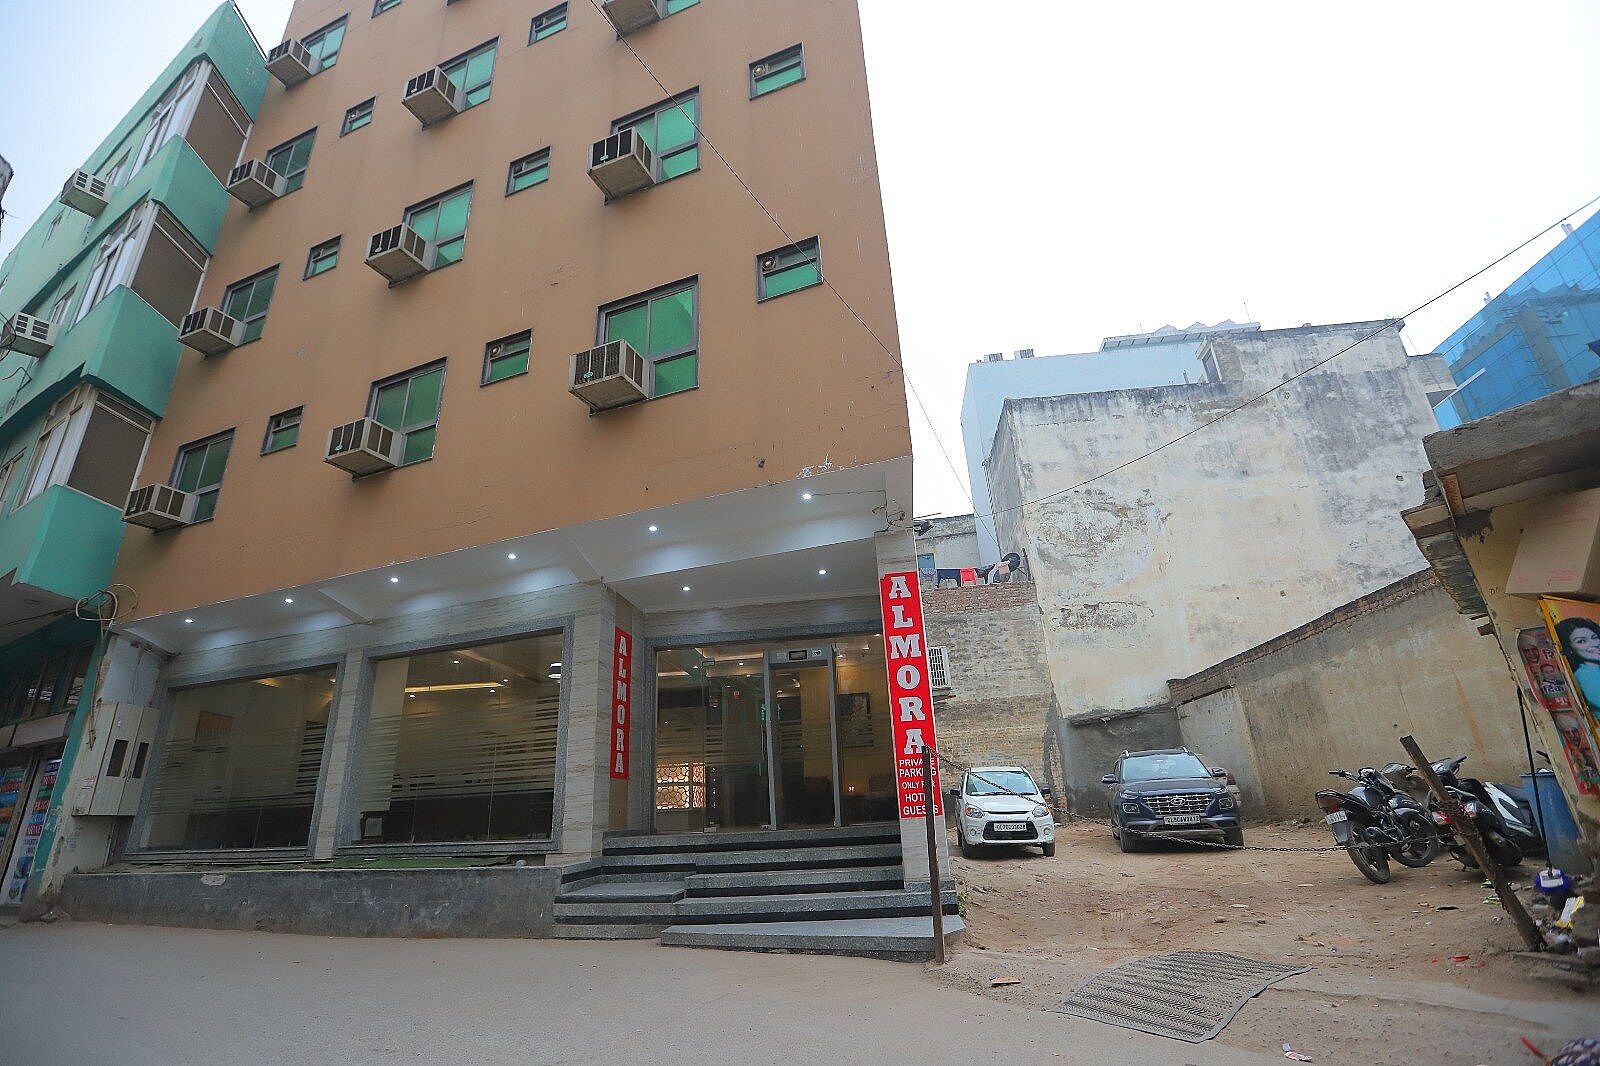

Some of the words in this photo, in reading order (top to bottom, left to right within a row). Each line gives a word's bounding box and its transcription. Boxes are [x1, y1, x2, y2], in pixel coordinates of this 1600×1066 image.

[889, 576, 926, 755] ALMORA
[615, 635, 628, 773] ALMORA
[899, 758, 935, 767] PRIVAE
[899, 767, 937, 778] PARKIG
[901, 781, 919, 790] ONLY
[903, 804, 939, 815] GUESS
